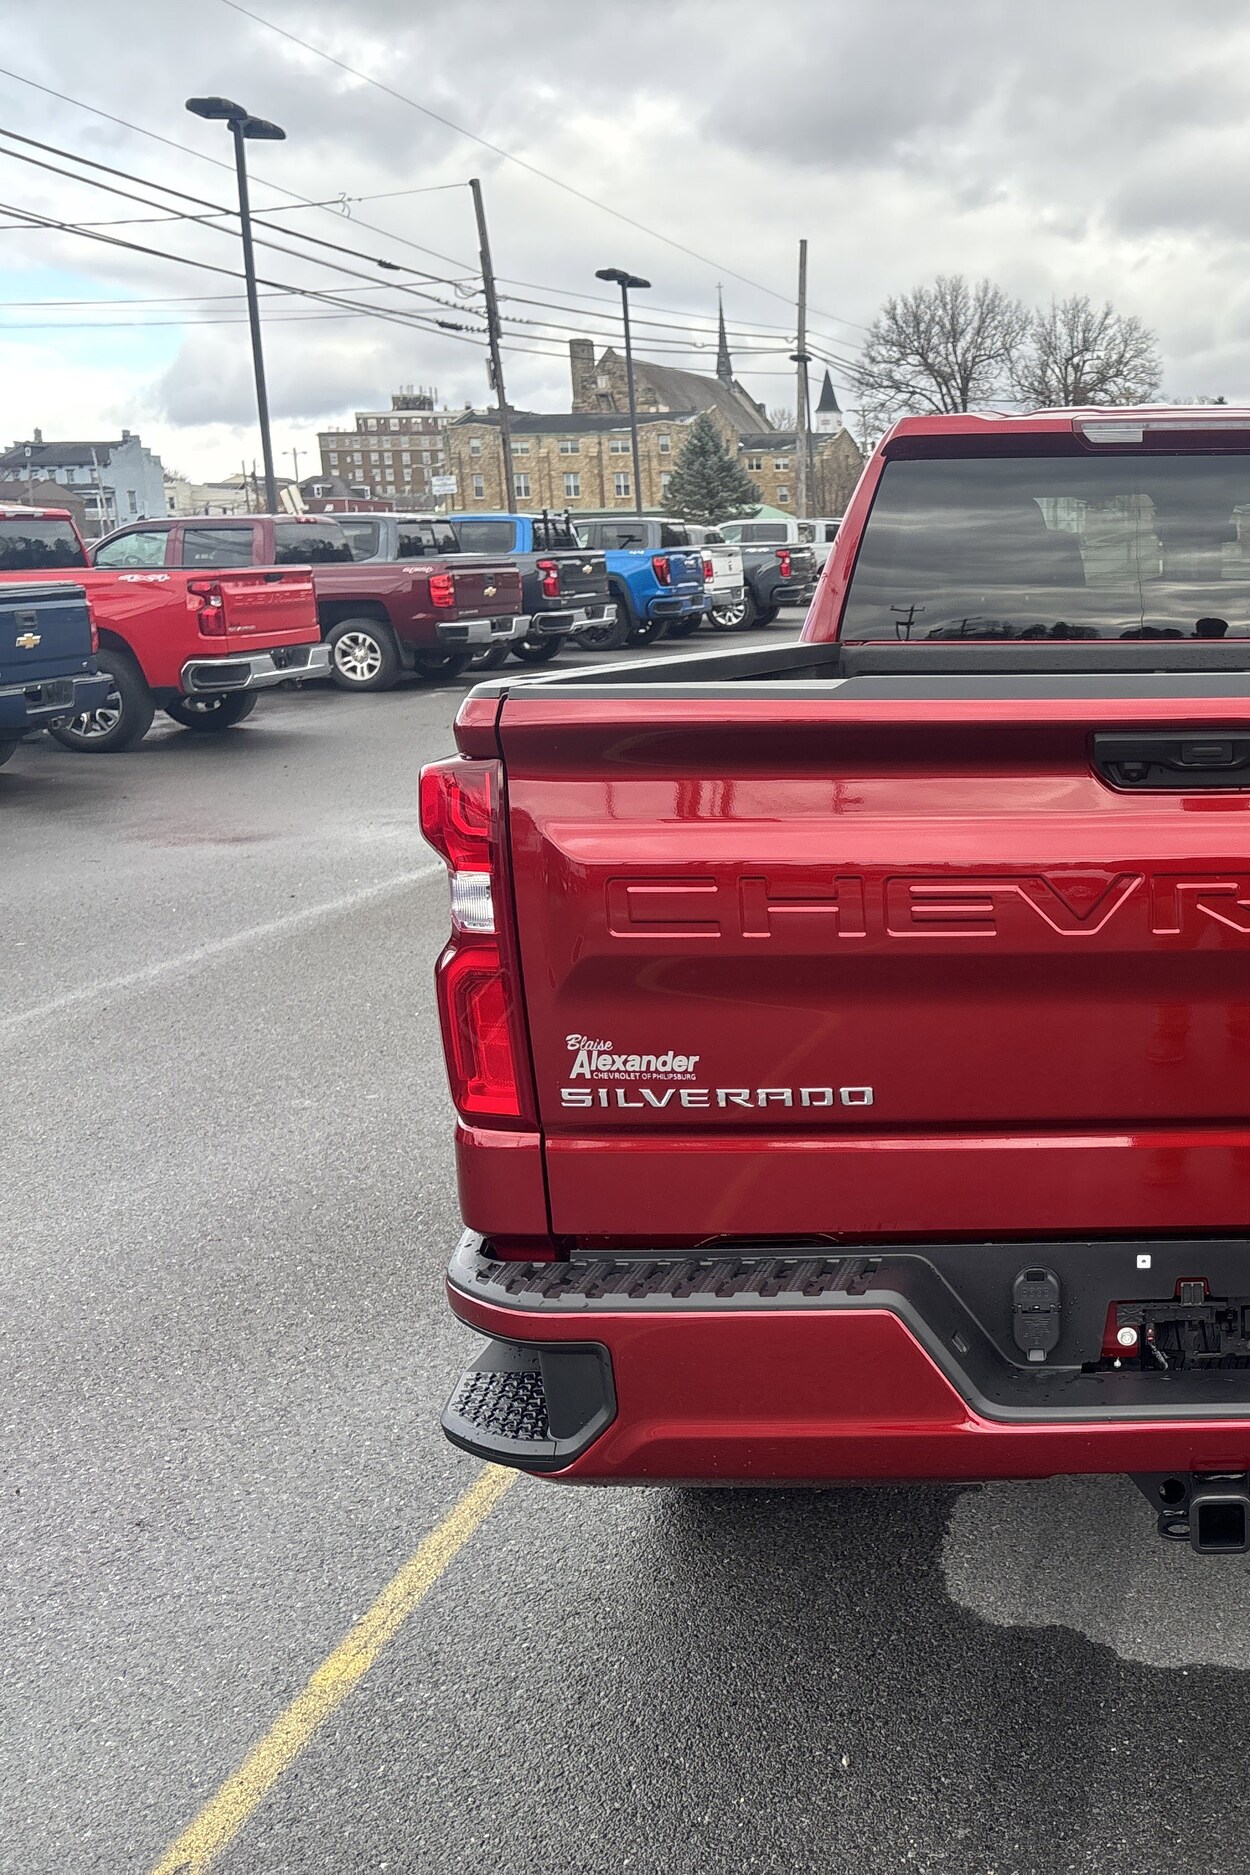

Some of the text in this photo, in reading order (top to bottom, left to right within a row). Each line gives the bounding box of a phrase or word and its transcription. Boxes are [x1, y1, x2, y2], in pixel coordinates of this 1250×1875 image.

[565, 1033, 613, 1051] Blaise
[569, 1049, 700, 1079] Alexander
[593, 1071, 697, 1081] CHEVROLET OF PHILIPSBURG
[560, 1086, 875, 1108] SILVERADO
